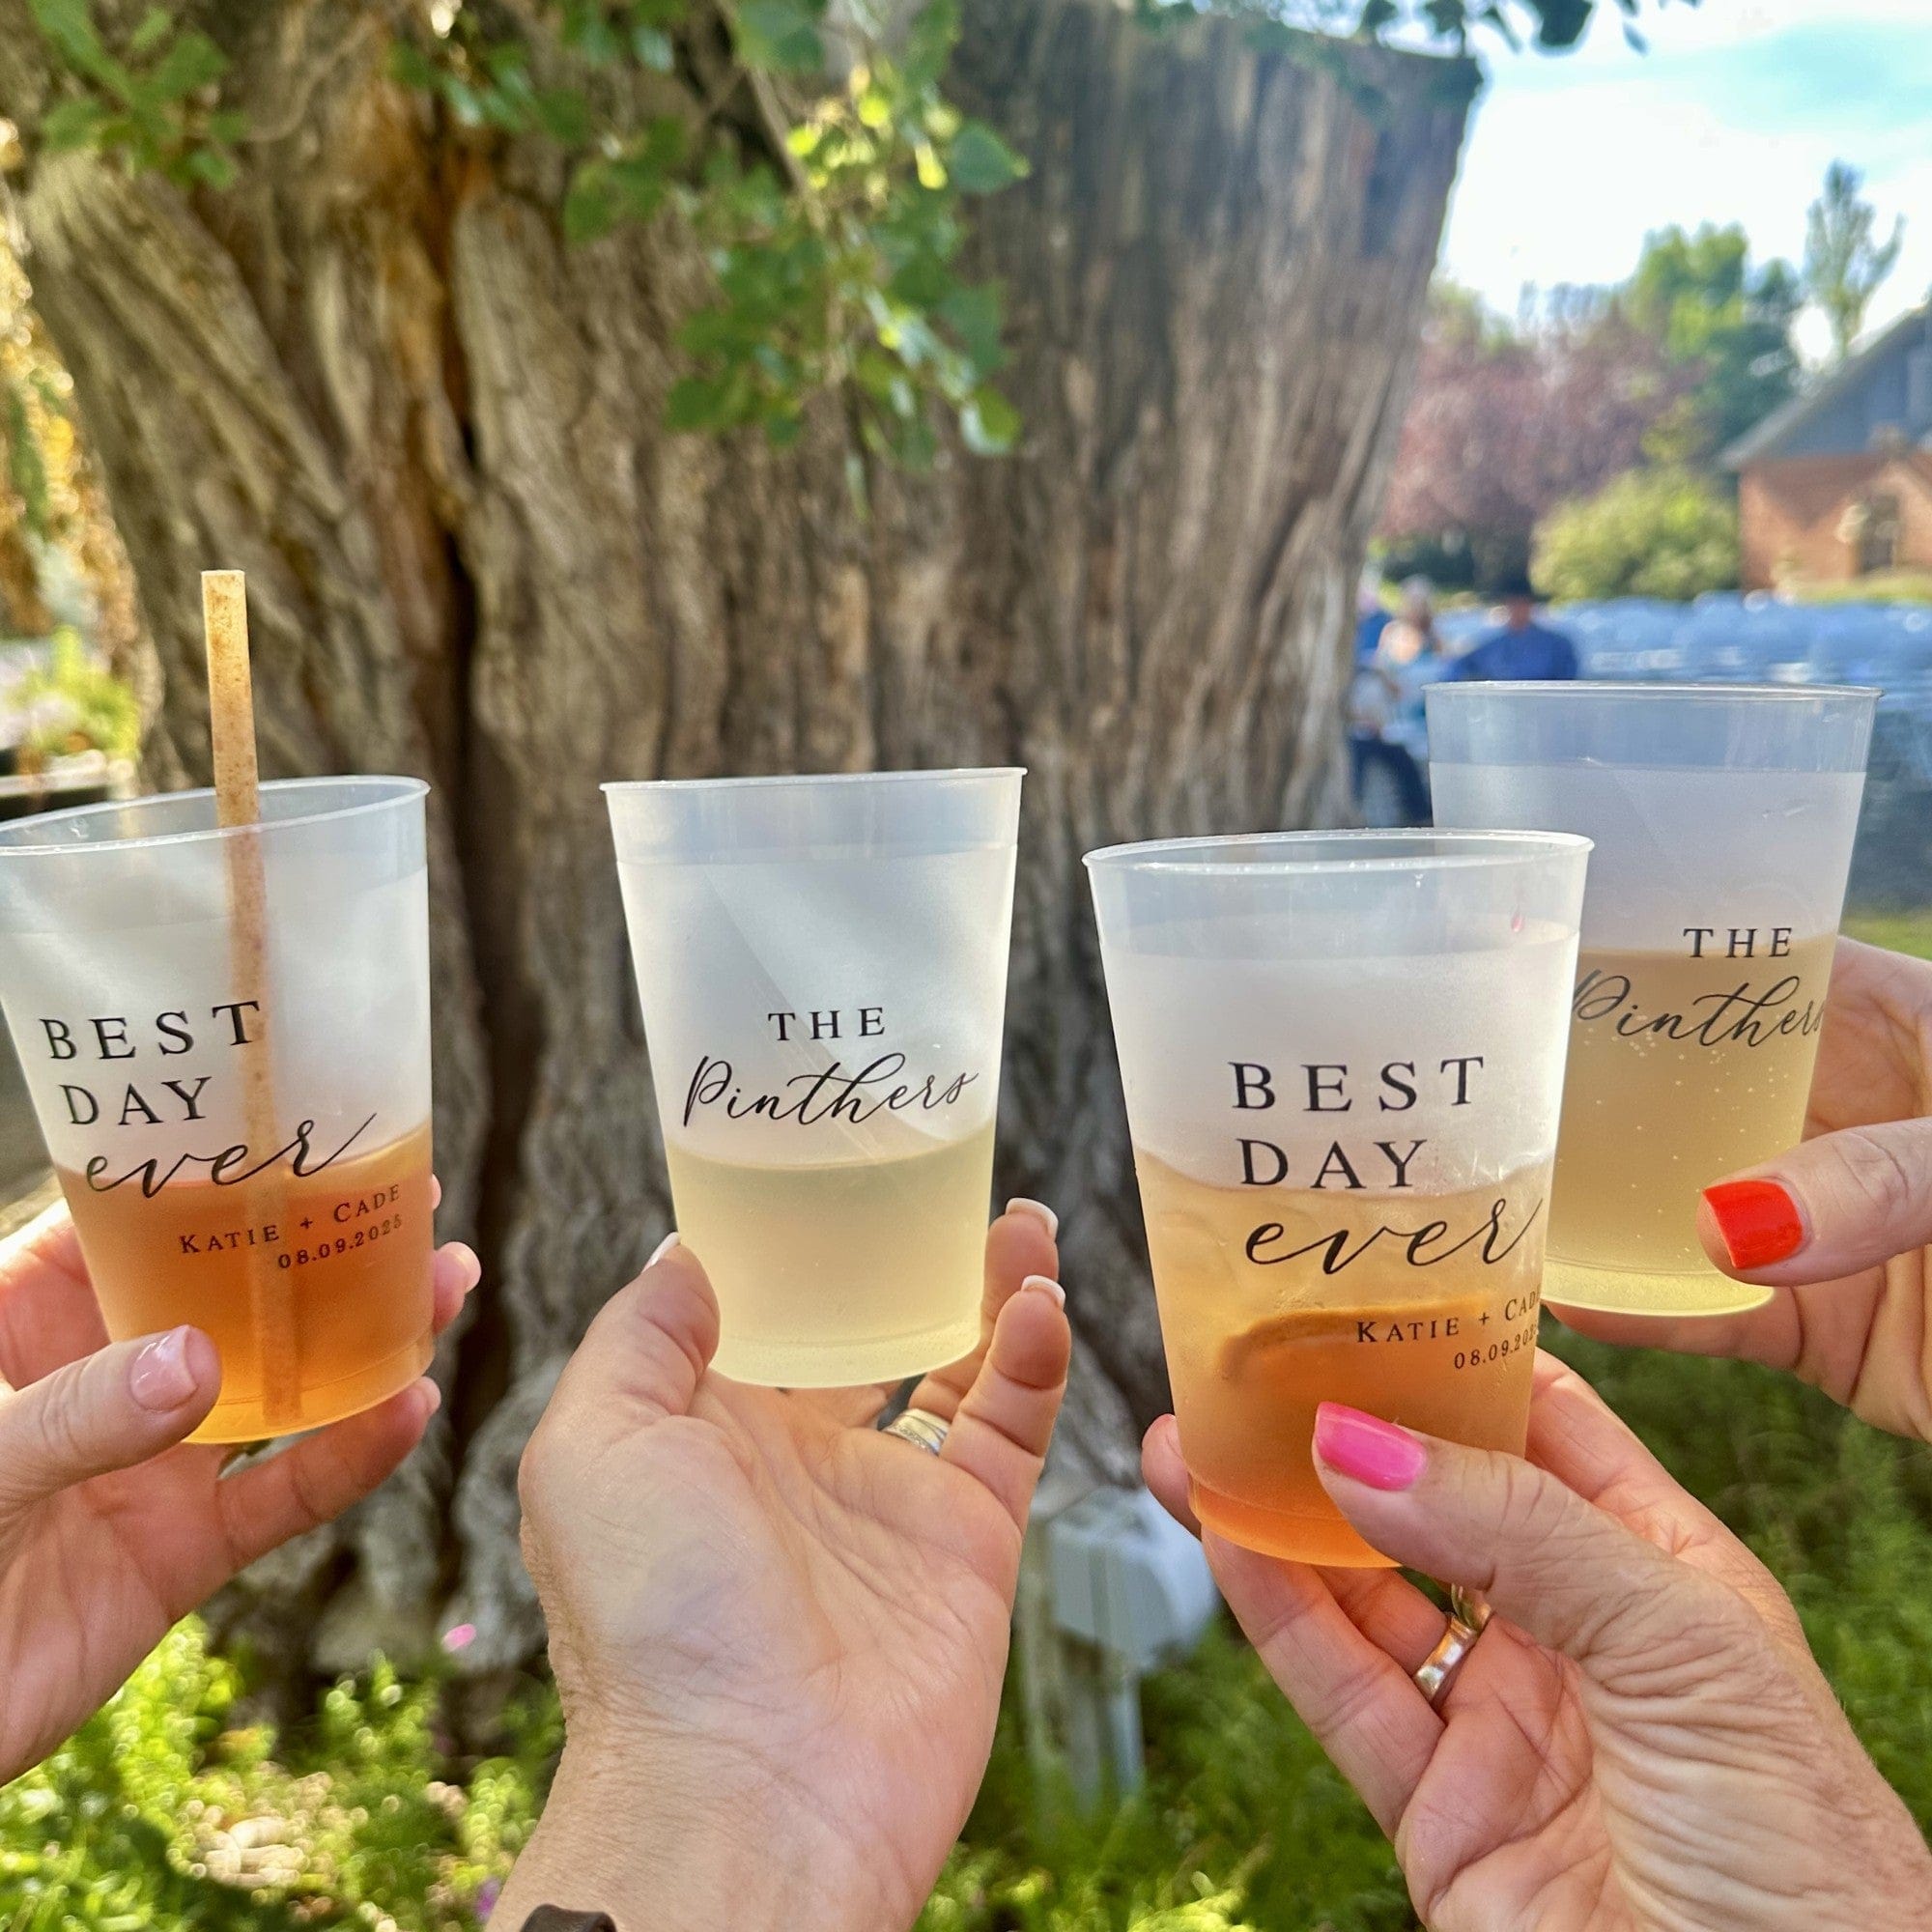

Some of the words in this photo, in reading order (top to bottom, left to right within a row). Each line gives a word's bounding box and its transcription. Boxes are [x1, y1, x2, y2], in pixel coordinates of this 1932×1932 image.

[1683, 927, 1792, 958] THE
[40, 1000, 260, 1061] BEST
[768, 1007, 886, 1040] THE
[59, 1076, 213, 1126] DAY
[683, 1052, 980, 1127] Pinthers
[1227, 1056, 1484, 1113] BEST
[85, 1112, 378, 1199] ever
[1236, 1138, 1428, 1190] DAY
[180, 1225, 280, 1254] KATIE
[299, 1216, 313, 1231] +
[333, 1183, 401, 1223] CADE
[277, 1213, 403, 1269] 08.09.2025
[1245, 1198, 1544, 1275] ever
[1356, 1317, 1460, 1344] KATIE
[1478, 1312, 1491, 1326] +
